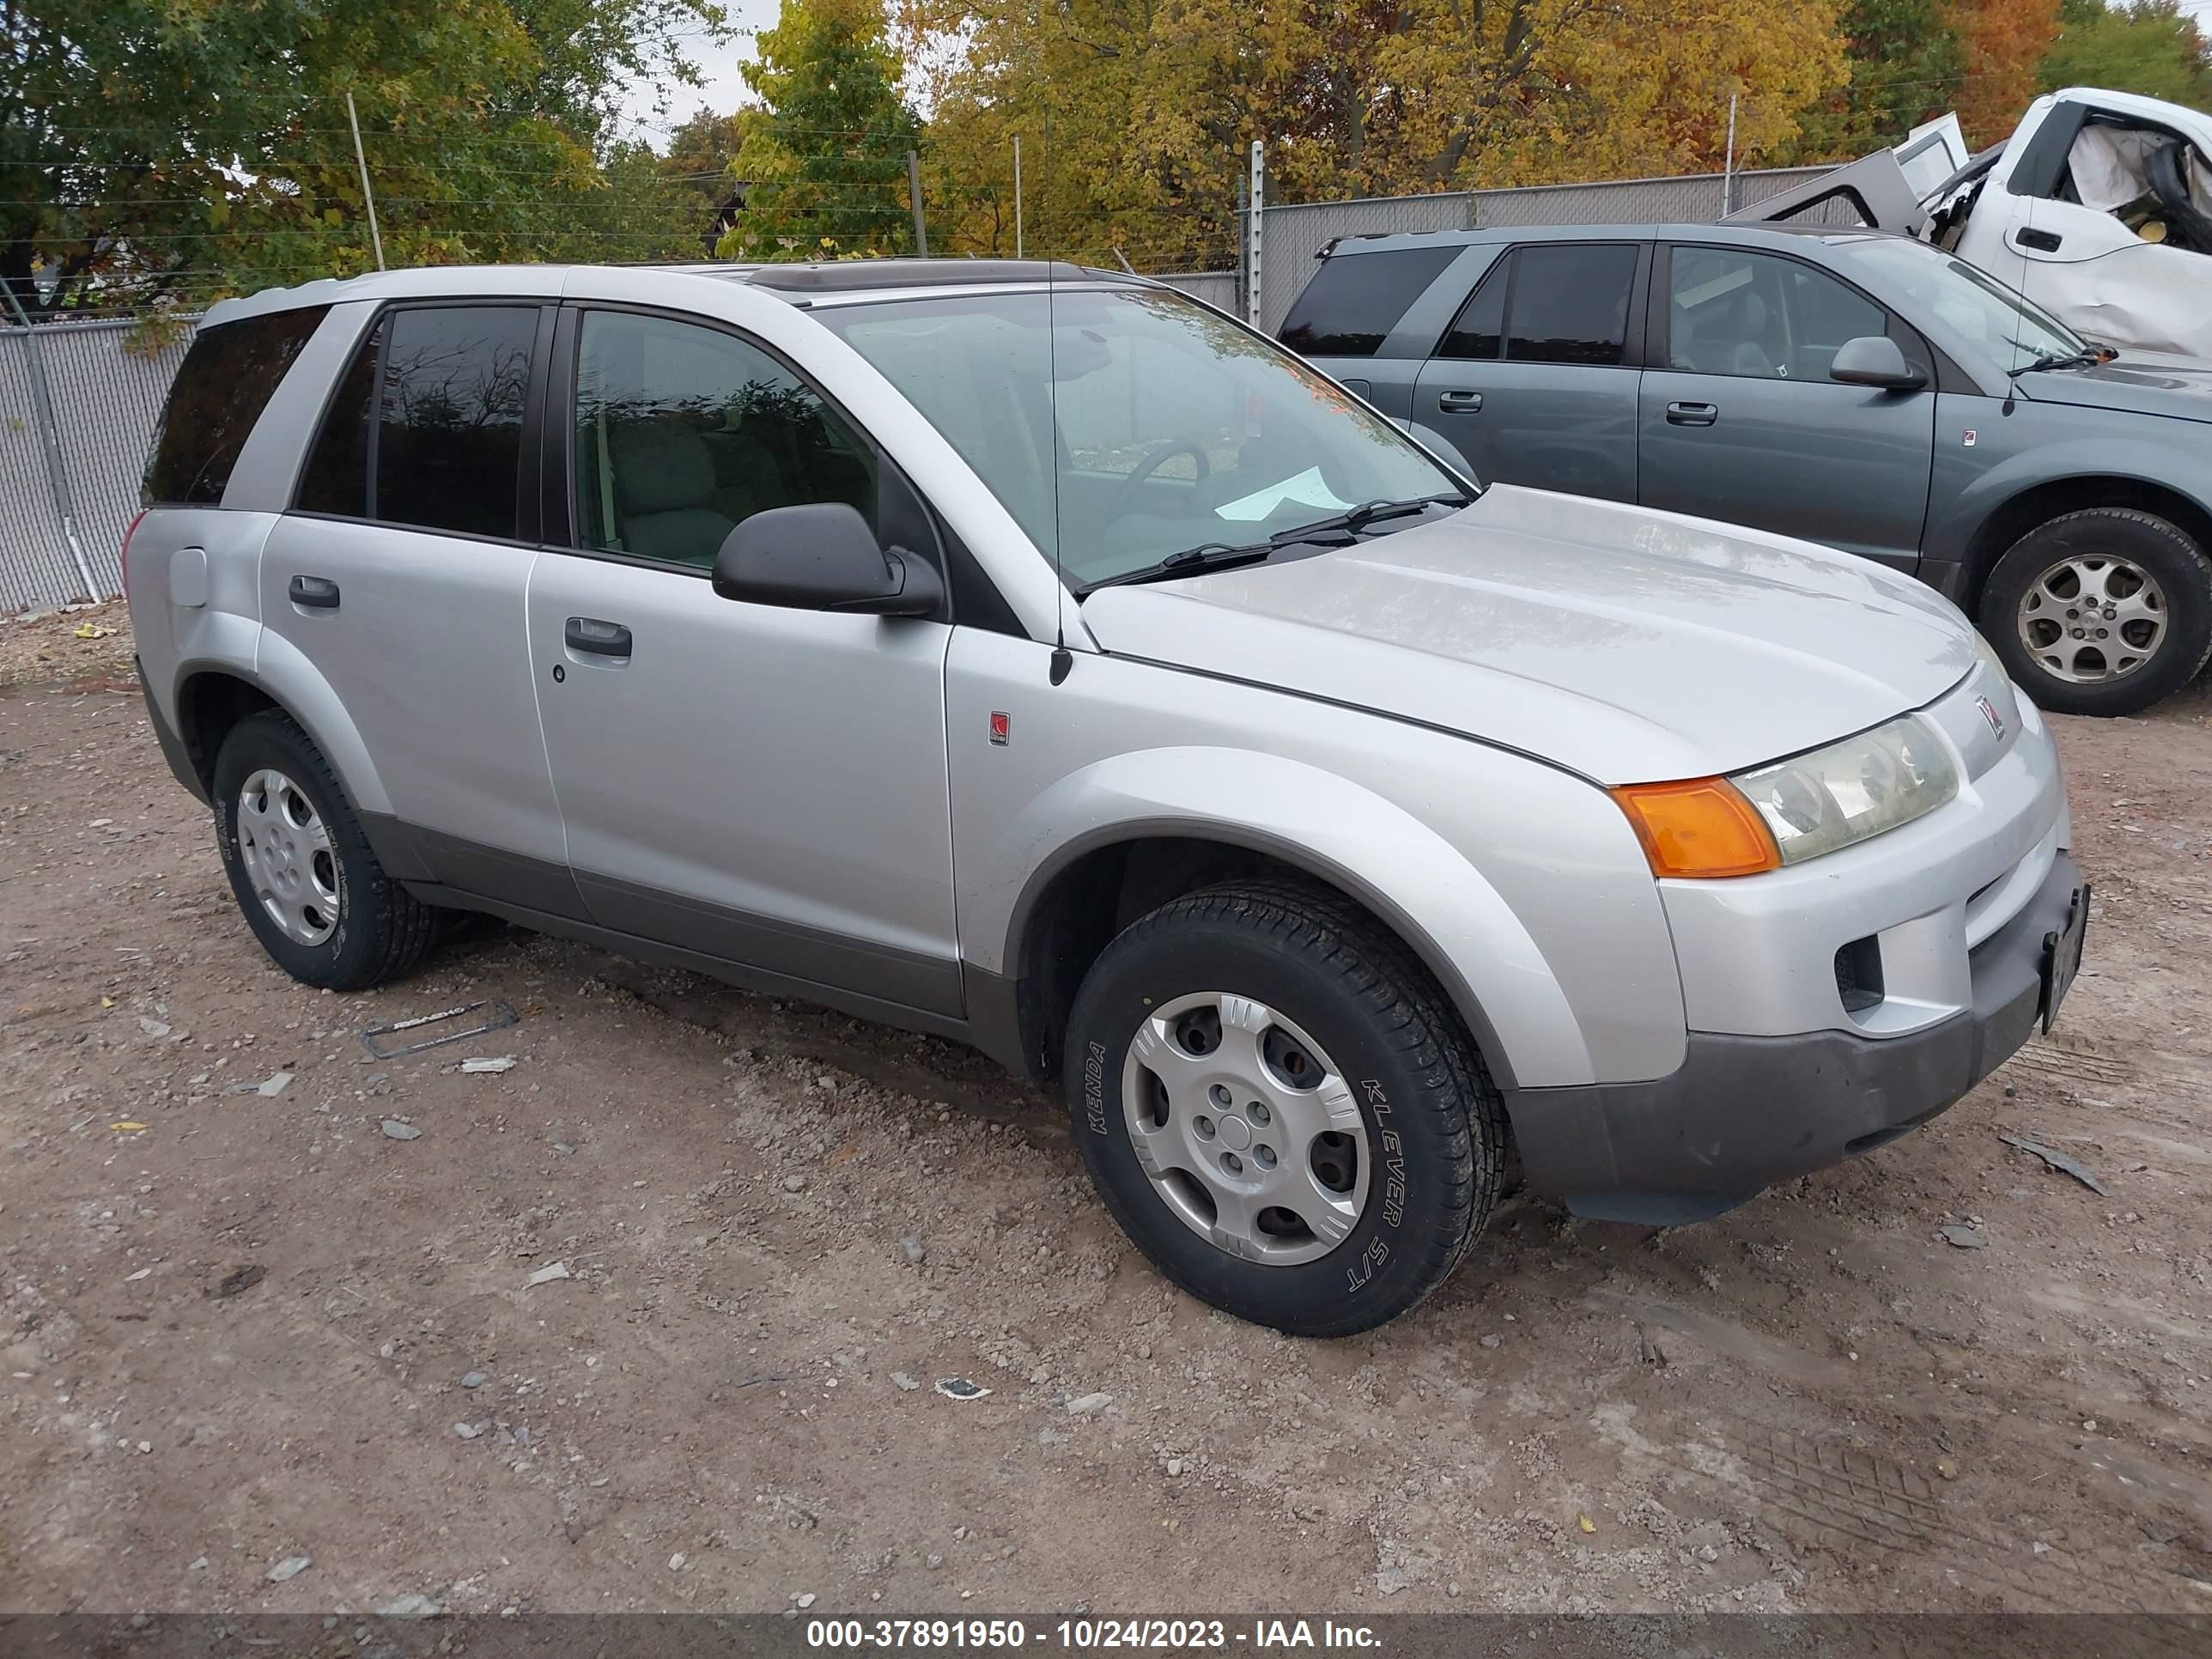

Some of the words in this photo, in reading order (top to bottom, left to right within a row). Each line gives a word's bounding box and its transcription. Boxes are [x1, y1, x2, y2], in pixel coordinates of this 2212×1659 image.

[1084, 1041, 1107, 1135] KENDA
[1360, 1079, 1407, 1229] KLEVER
[1346, 1236, 1390, 1293] S/T
